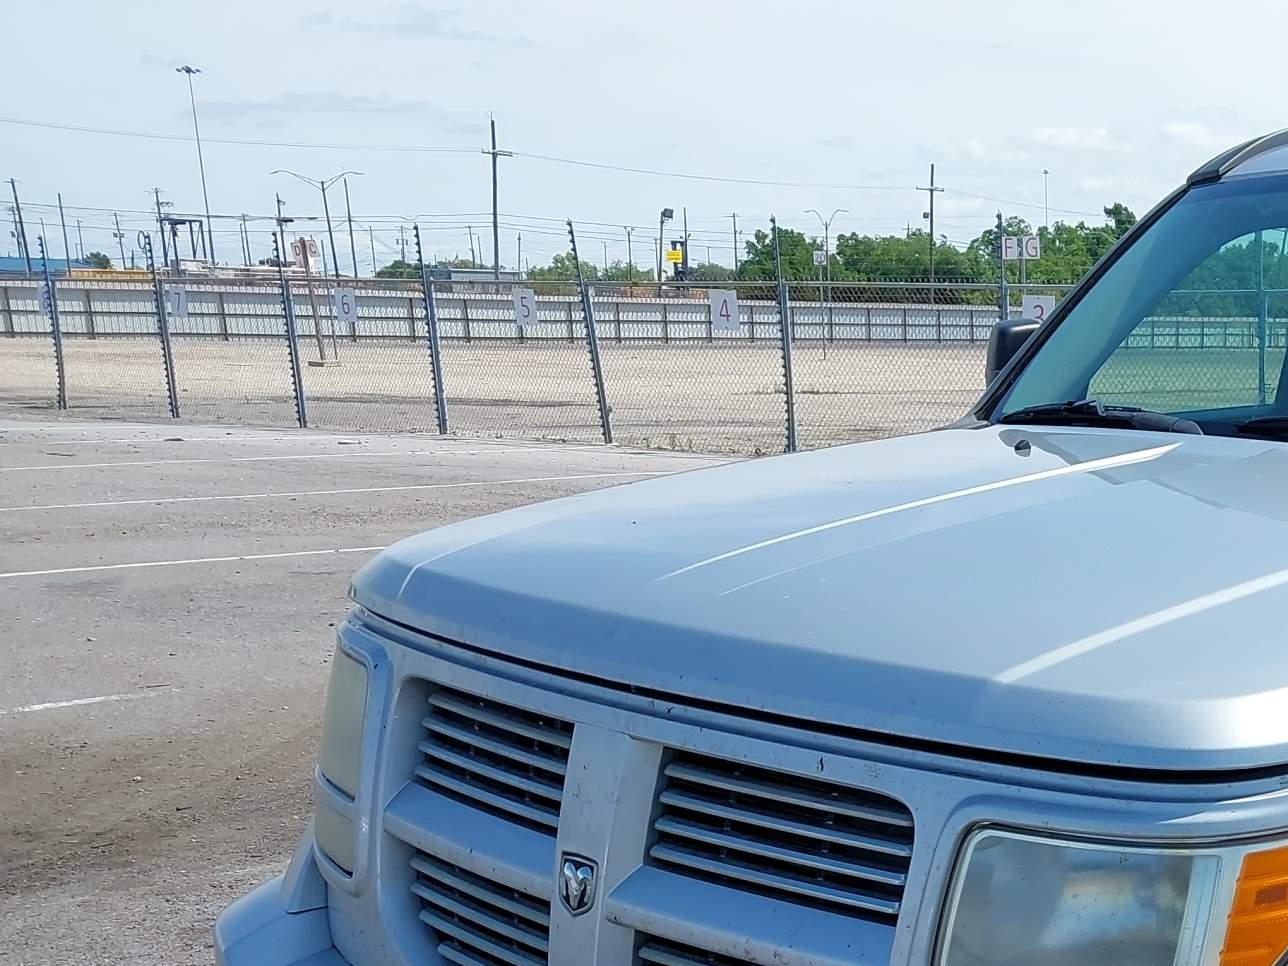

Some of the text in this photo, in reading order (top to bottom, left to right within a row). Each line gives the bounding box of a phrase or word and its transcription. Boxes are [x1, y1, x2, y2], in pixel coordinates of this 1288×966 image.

[1004, 238, 1039, 258] F G
[173, 293, 182, 312] 7
[341, 294, 351, 315] 6
[519, 296, 532, 319] 5
[719, 298, 731, 321] 4
